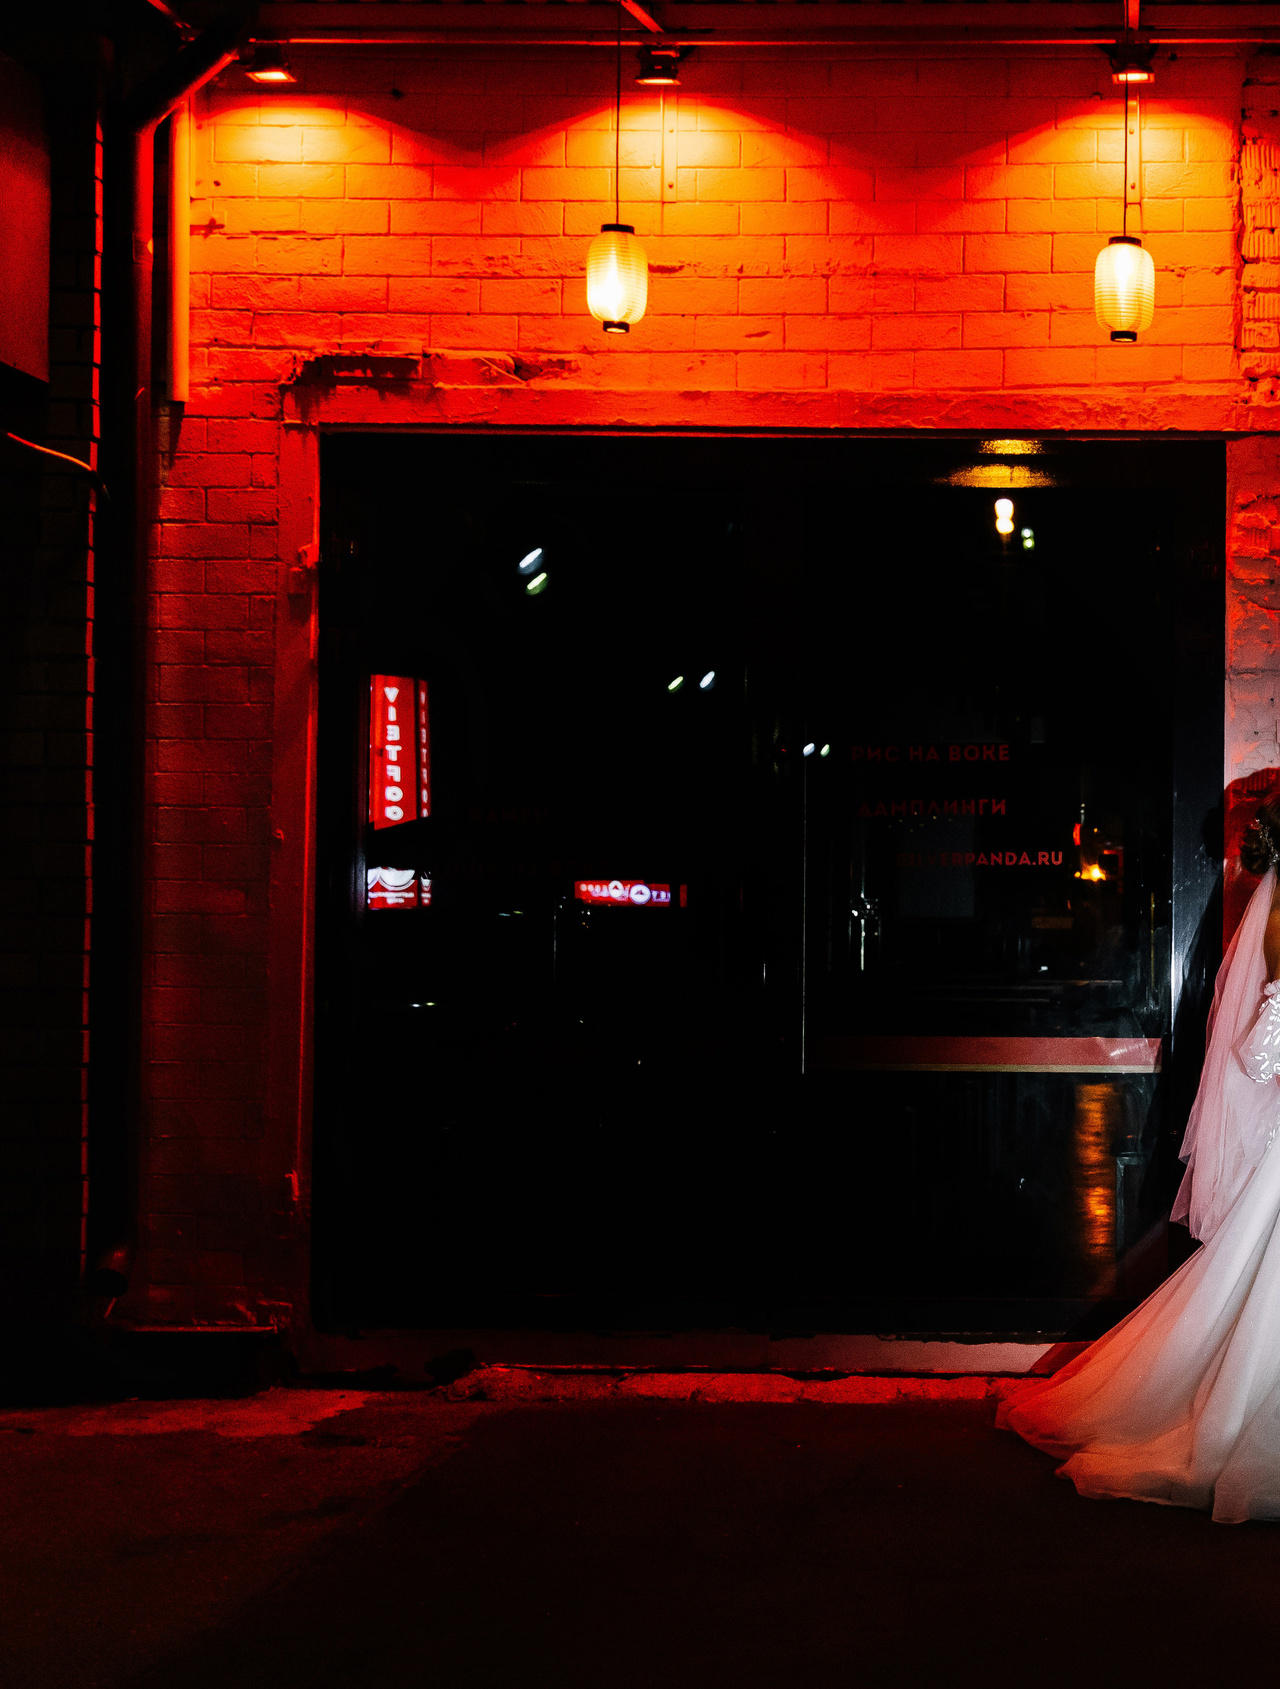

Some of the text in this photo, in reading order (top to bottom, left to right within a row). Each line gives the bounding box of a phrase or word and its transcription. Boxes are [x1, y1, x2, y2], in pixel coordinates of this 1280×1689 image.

[851, 743, 1011, 763] РИС НА ВОКЕ
